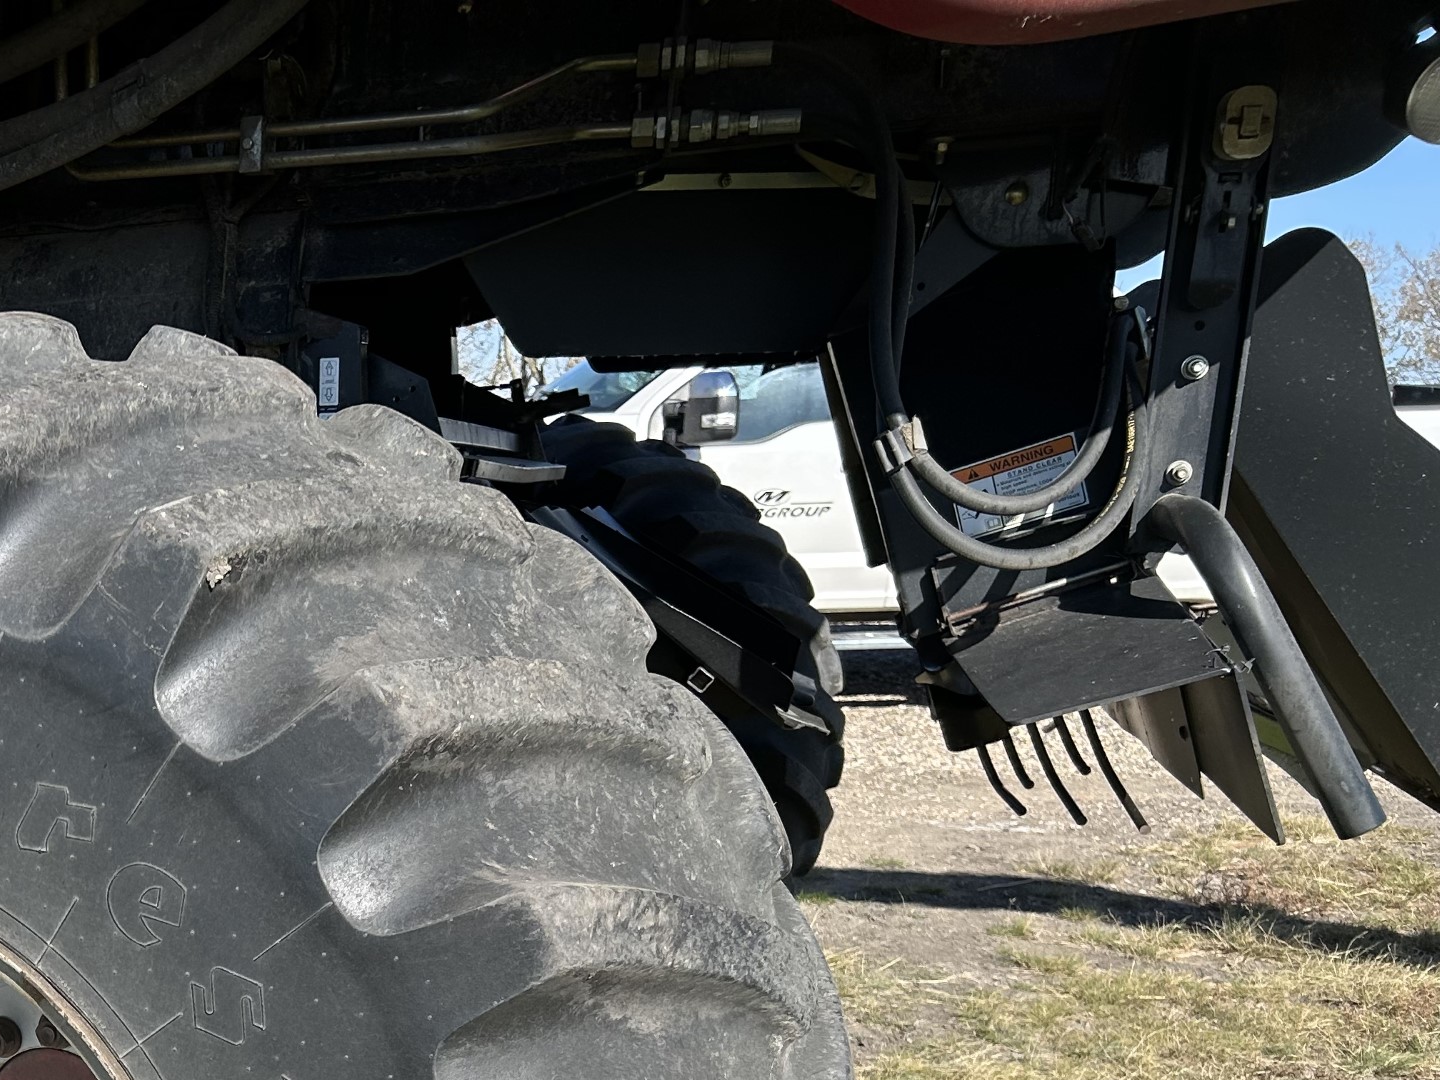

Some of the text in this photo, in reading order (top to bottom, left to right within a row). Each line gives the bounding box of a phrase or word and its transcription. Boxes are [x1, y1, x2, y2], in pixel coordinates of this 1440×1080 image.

[989, 445, 1054, 471] WARNING
[1006, 456, 1063, 478] STAND CLEAR
